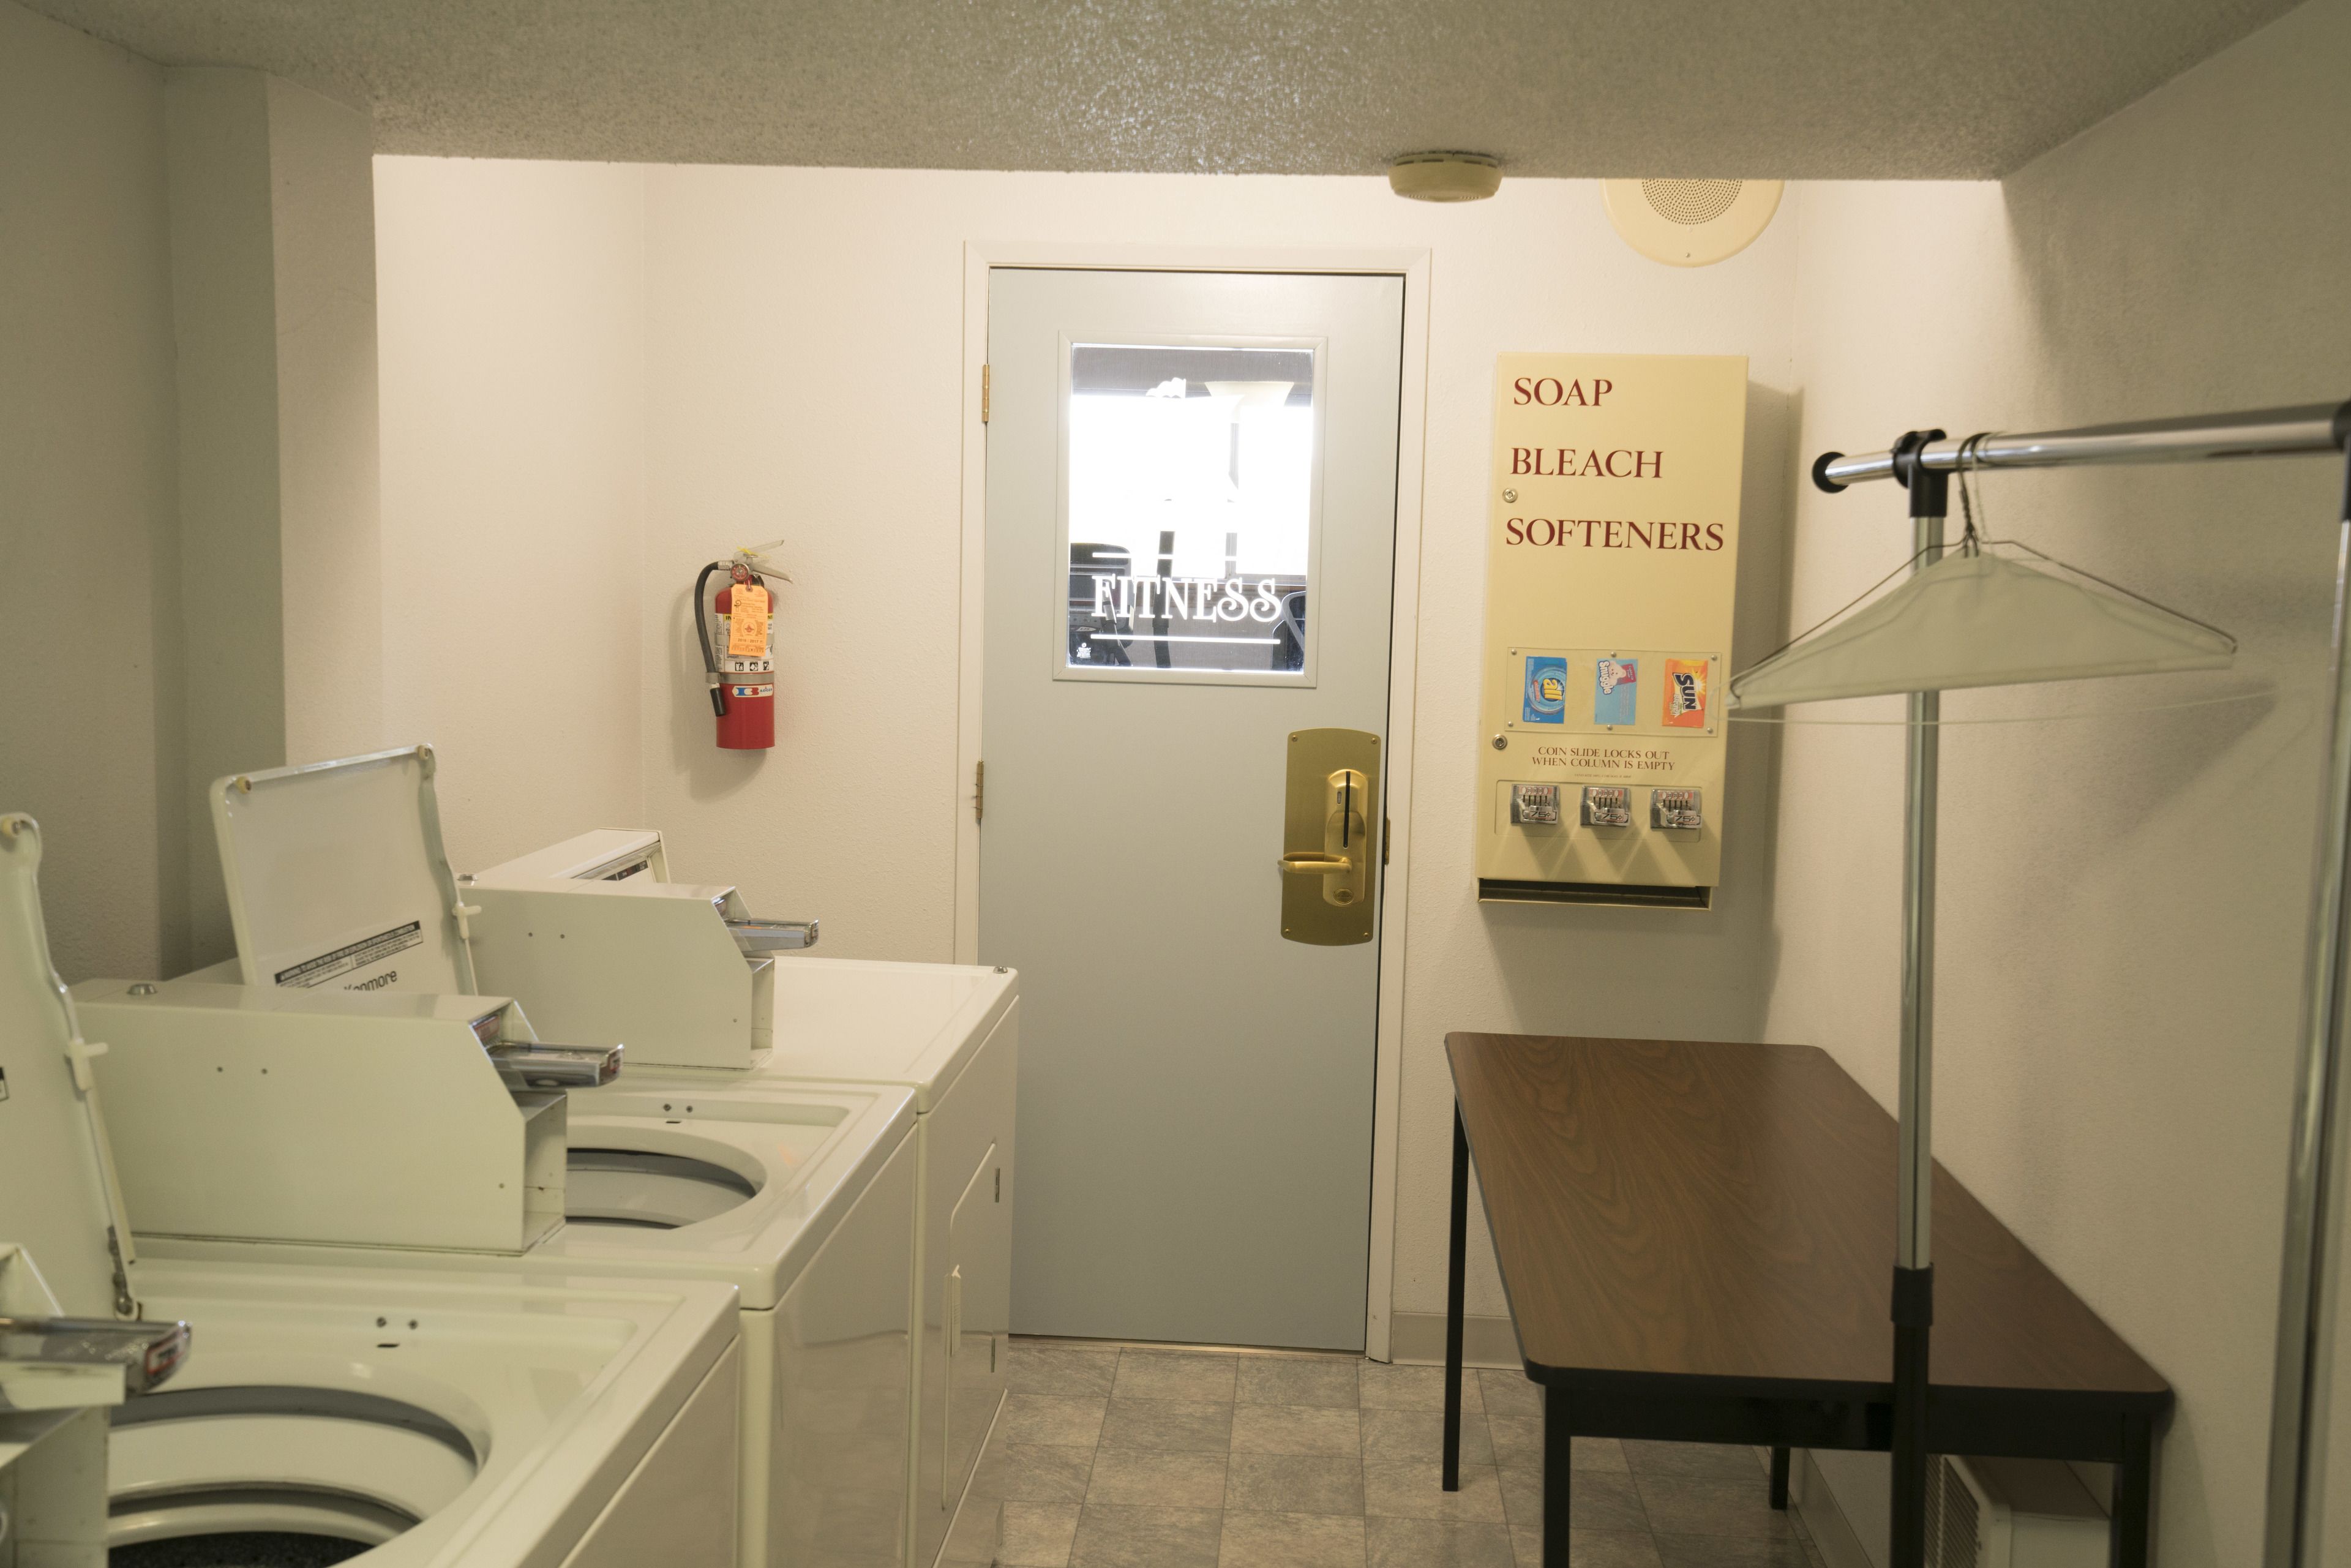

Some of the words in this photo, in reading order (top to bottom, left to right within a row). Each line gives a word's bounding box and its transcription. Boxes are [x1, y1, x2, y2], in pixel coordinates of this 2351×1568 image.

[1513, 377, 1613, 407] SOAP
[1510, 447, 1664, 478] BLEACH
[1505, 518, 1723, 551] SOFTENERS
[1091, 574, 1282, 623] FITNESS
[1543, 678, 1563, 701] all
[1598, 661, 1614, 695] Snuggle
[1673, 673, 1697, 710] SUN
[1532, 757, 1566, 766] WHEN
[1571, 759, 1619, 768] COLUMN
[1637, 761, 1675, 770] EMPTY
[1538, 746, 1567, 756] COIN
[1570, 748, 1600, 757] SLIDE
[1605, 749, 1641, 759] LOCKS
[1645, 751, 1670, 759] OUT
